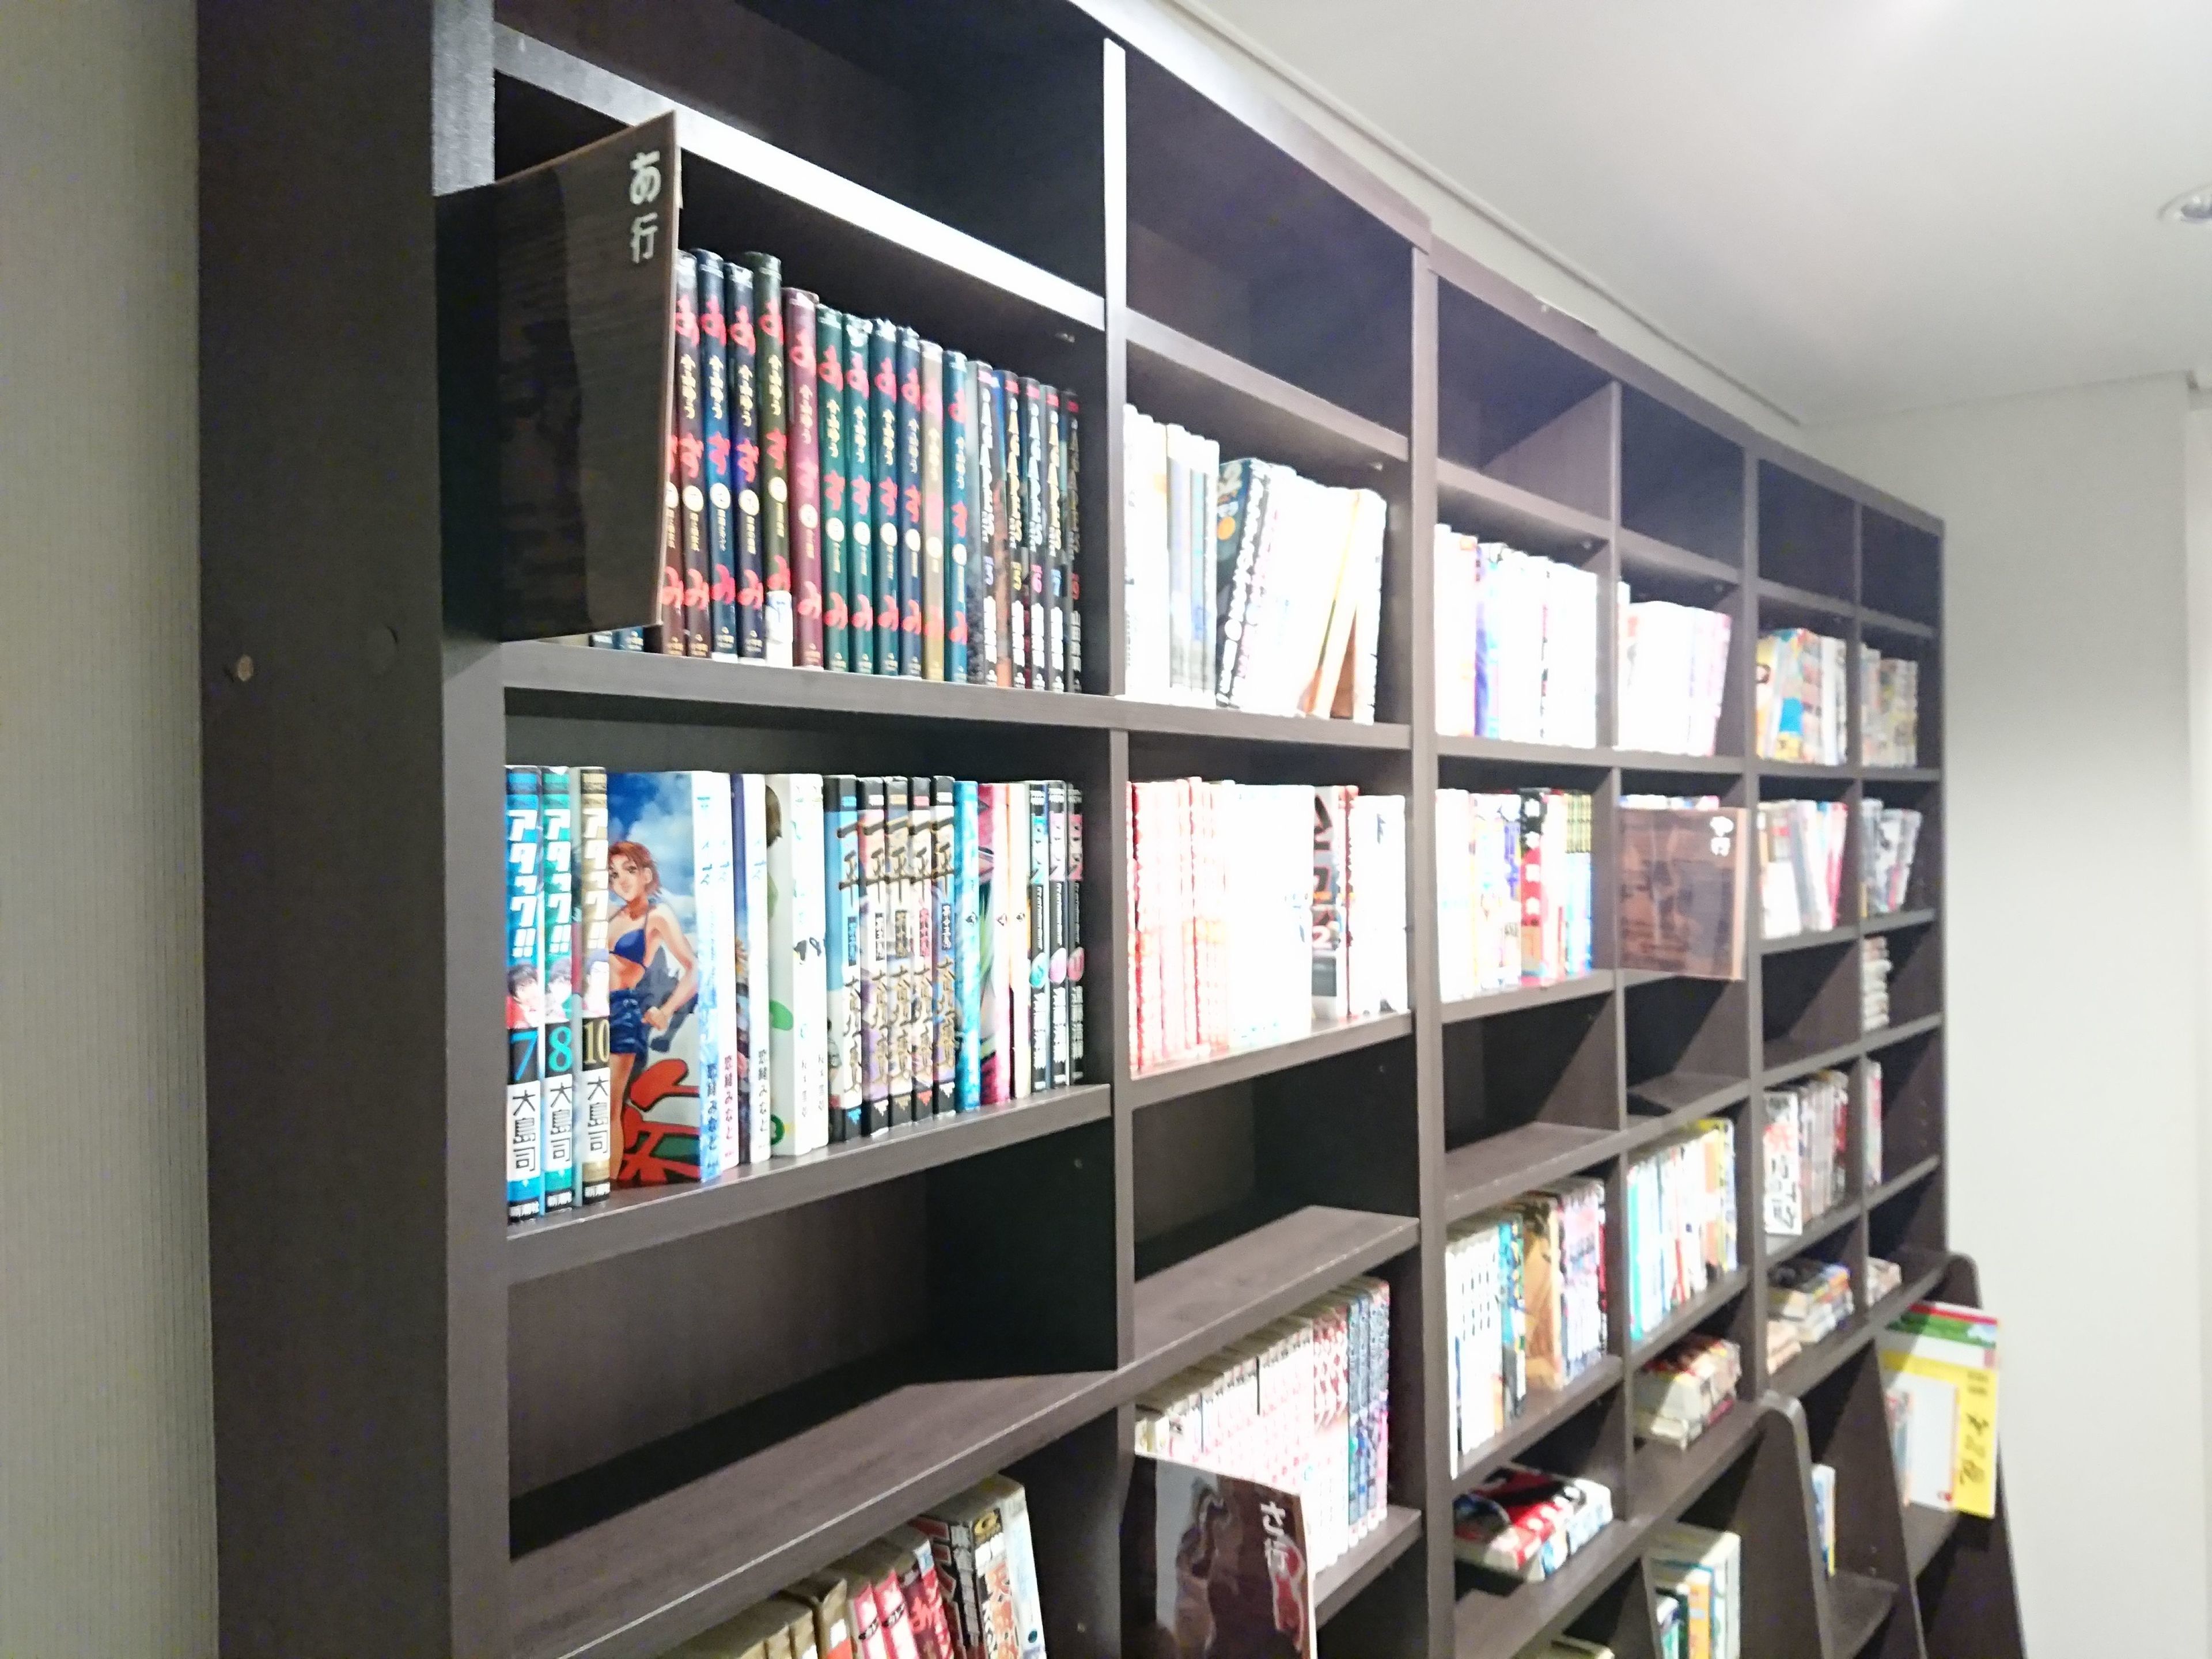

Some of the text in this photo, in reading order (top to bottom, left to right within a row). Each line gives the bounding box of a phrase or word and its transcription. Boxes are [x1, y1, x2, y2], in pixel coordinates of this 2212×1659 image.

[628, 149, 661, 264] あ行
[510, 1032, 538, 1081] 7
[548, 1026, 573, 1073] 8
[583, 1018, 610, 1065] 10
[513, 1090, 536, 1171] 大島司
[550, 1082, 572, 1162] 大島司
[588, 1076, 609, 1154] 大島司
